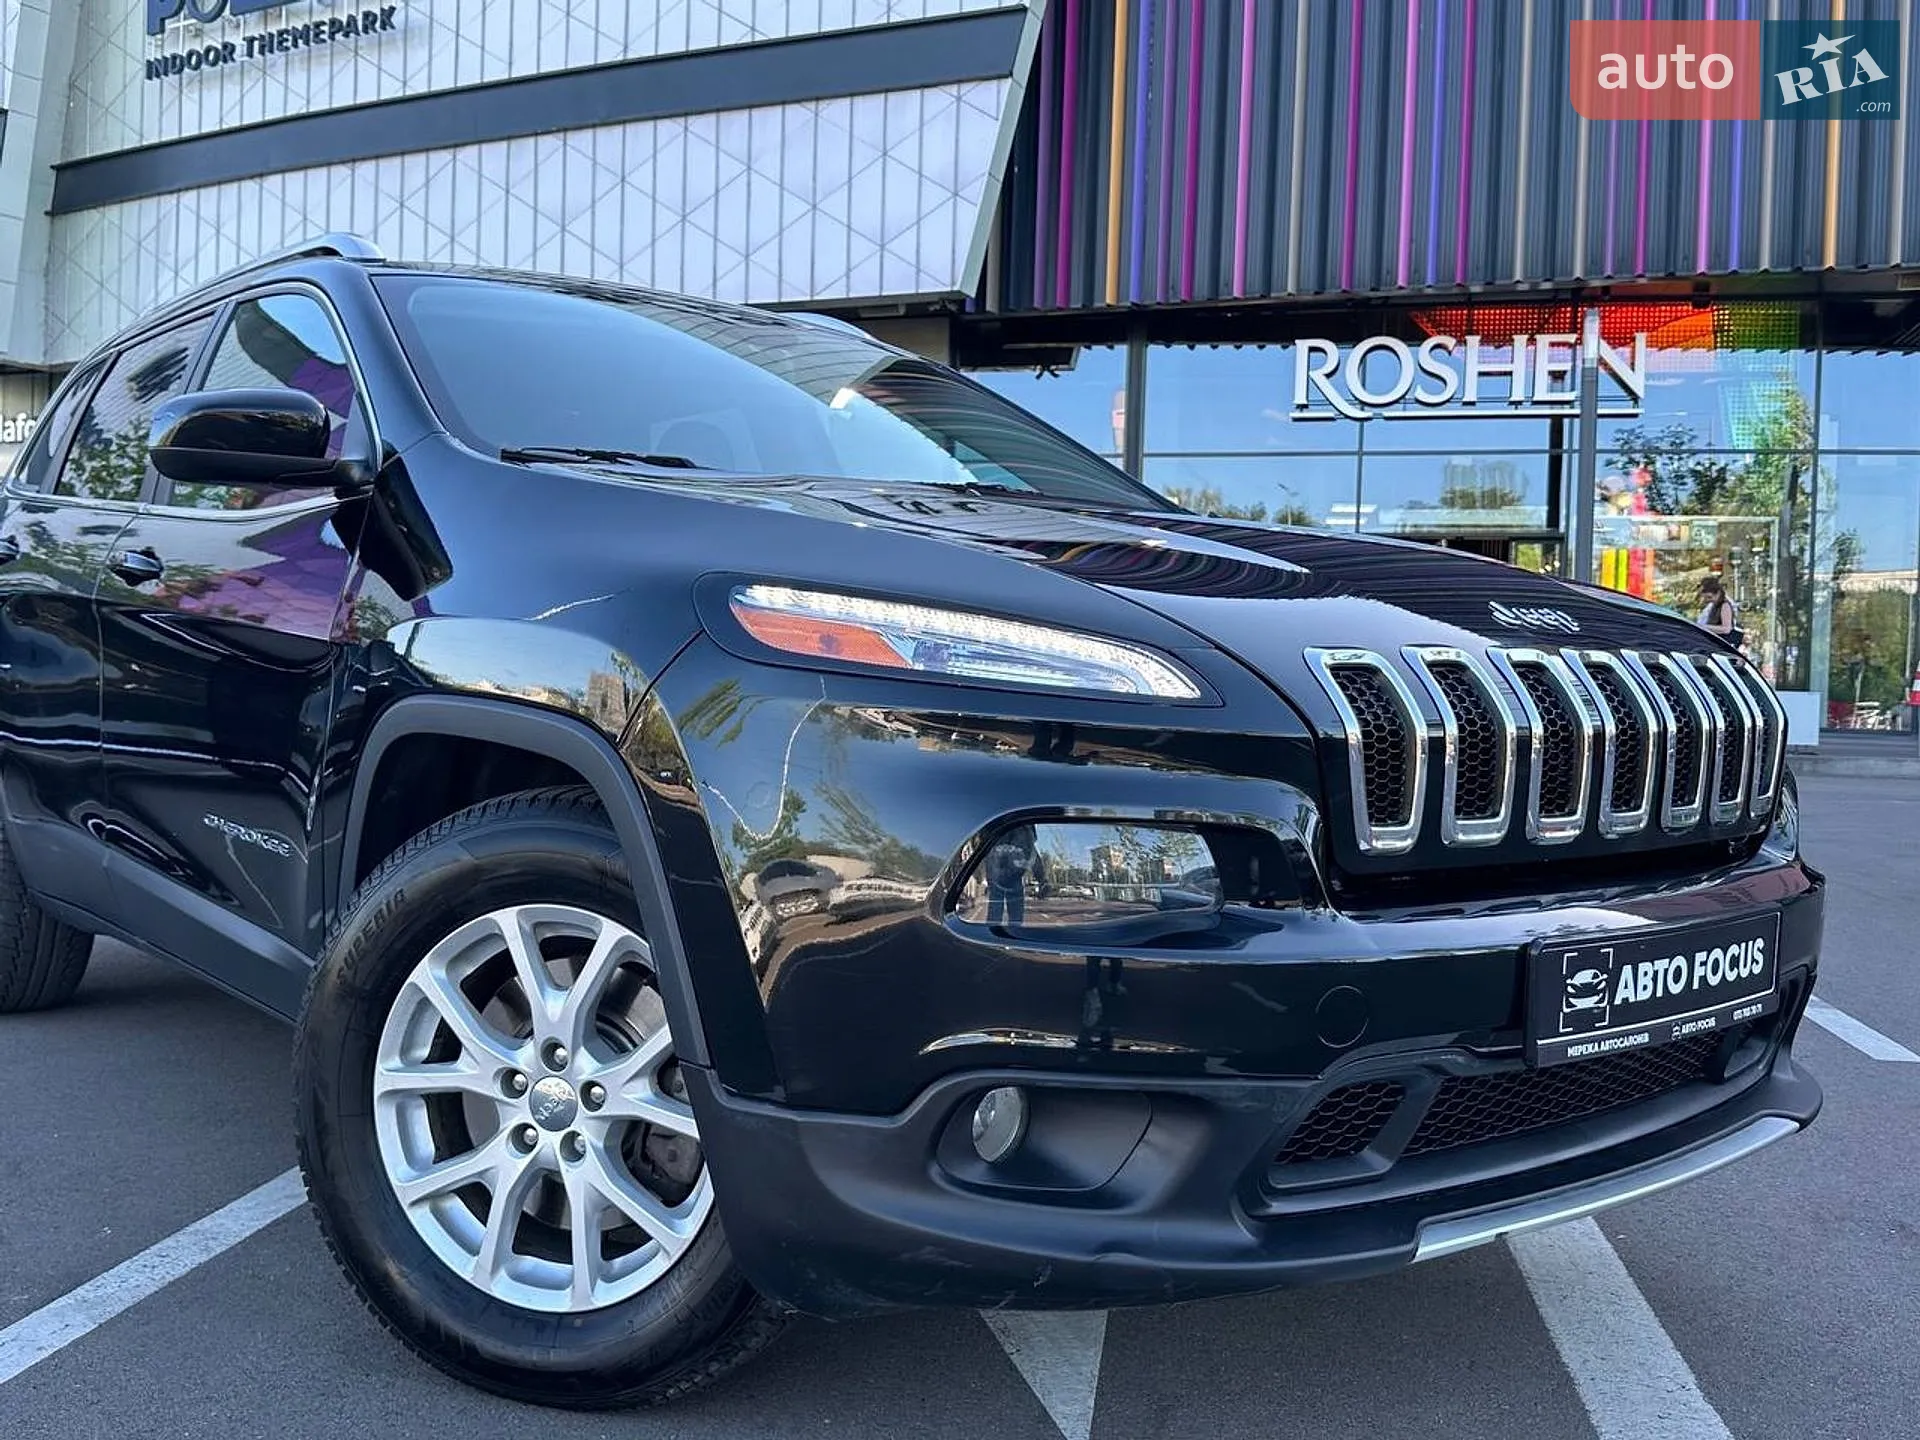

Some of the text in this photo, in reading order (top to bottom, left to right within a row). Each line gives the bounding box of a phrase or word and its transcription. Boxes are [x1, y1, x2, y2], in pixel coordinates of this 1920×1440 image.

[145, 41, 236, 81] INDOOR
[242, 5, 397, 59] THEMEPARK
[1293, 332, 1647, 420] ROSHEN
[1488, 601, 1581, 634] Jeep
[203, 813, 290, 857] CHEROKEE
[1614, 937, 1765, 1005] АВТО FOCUS
